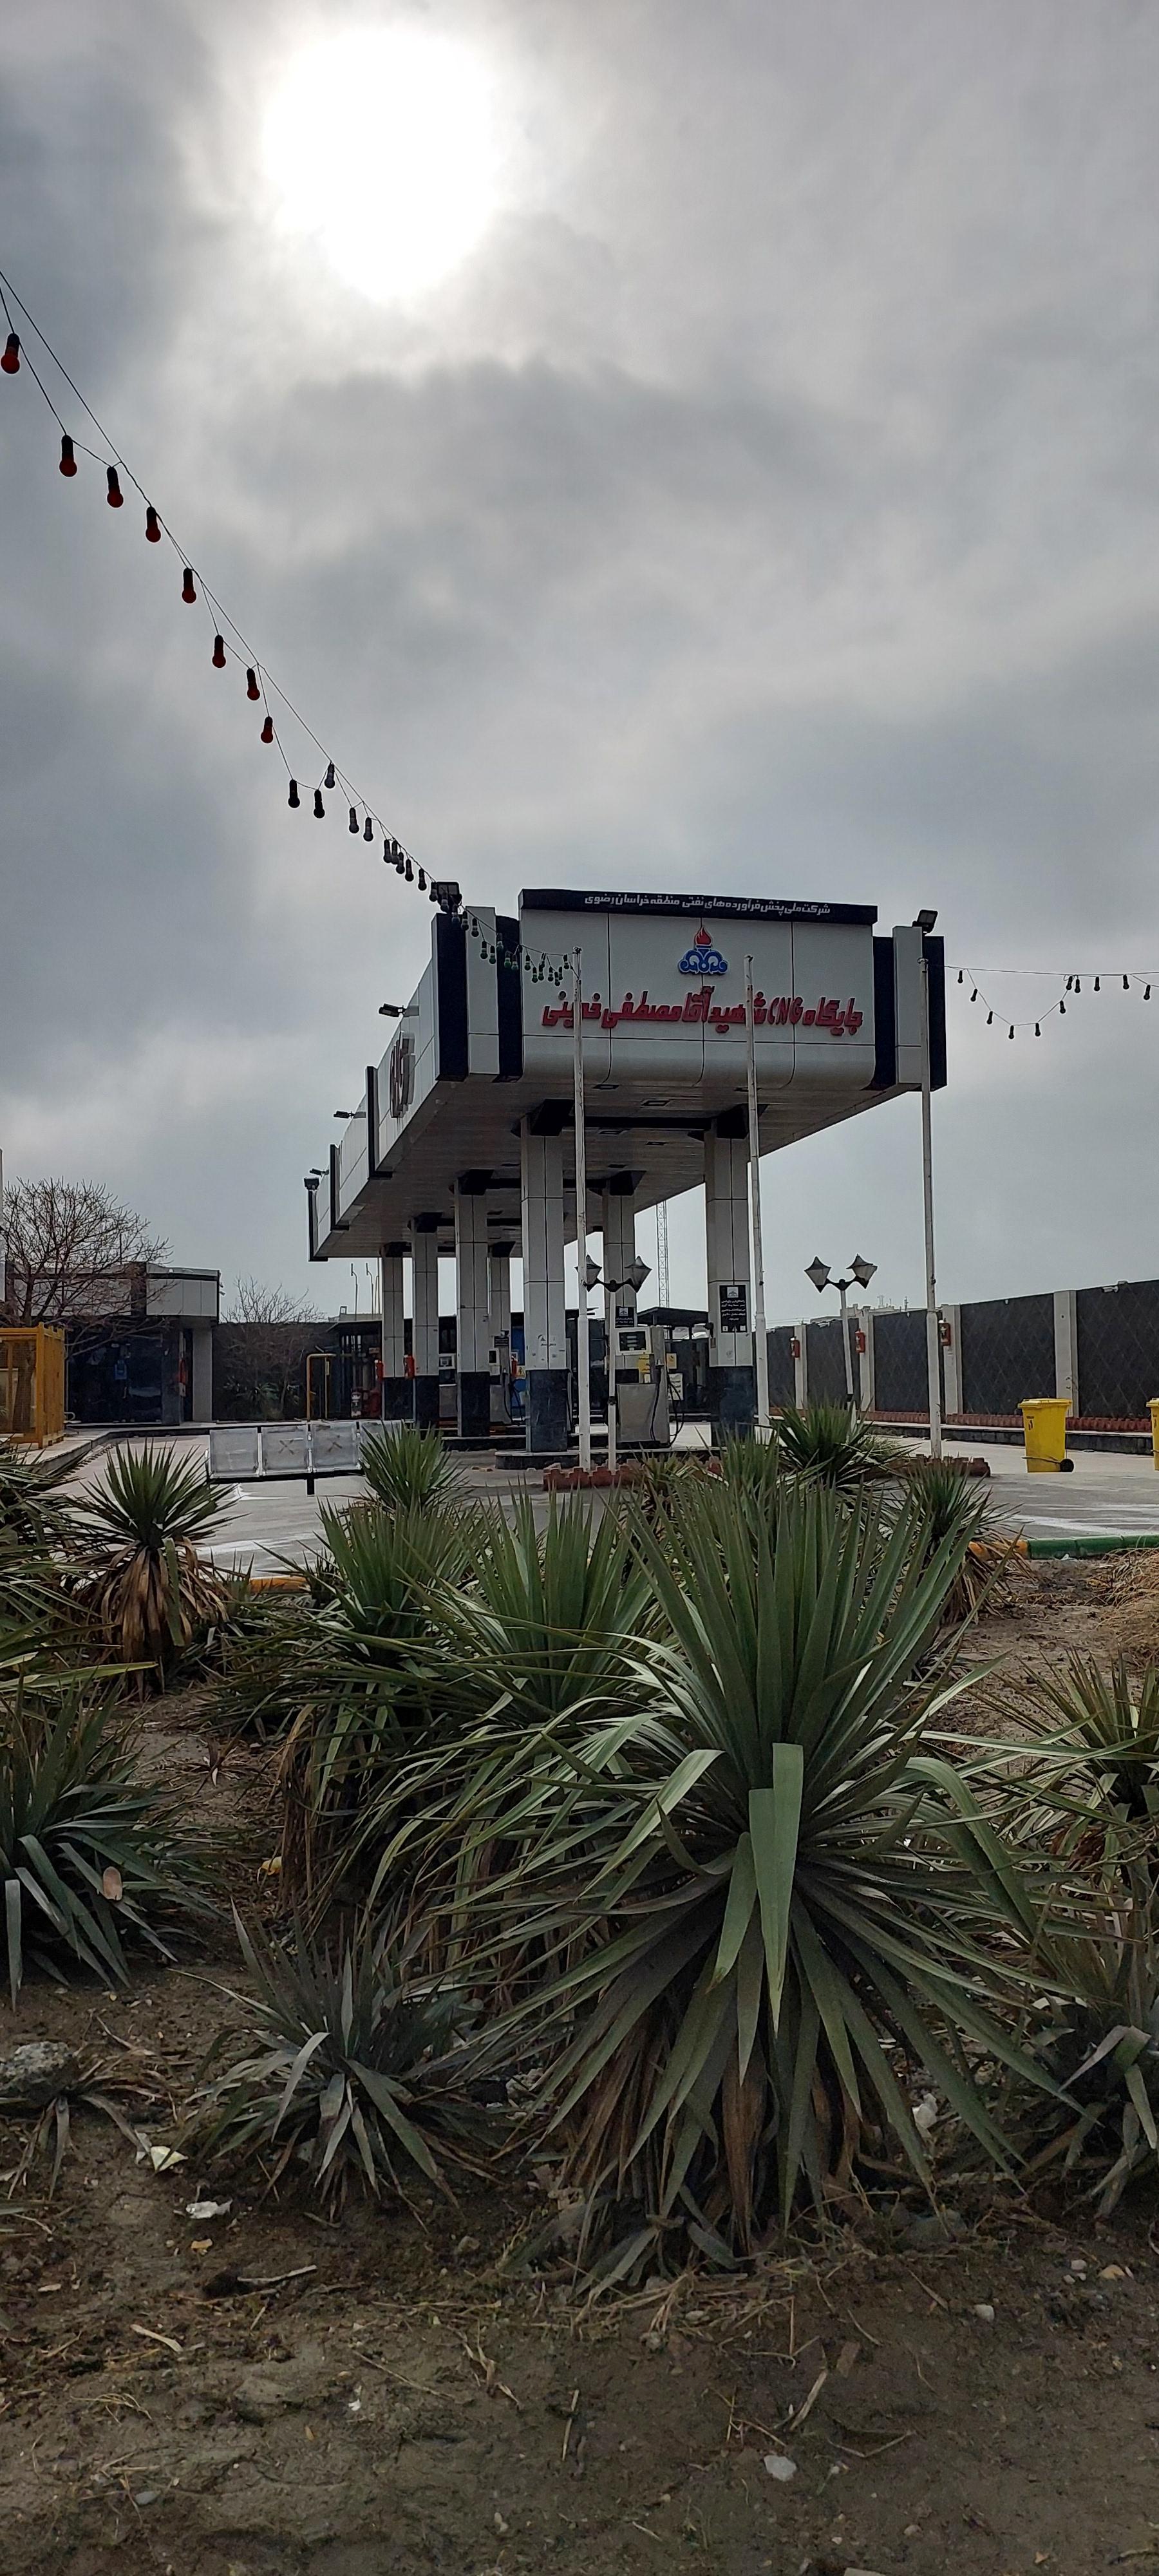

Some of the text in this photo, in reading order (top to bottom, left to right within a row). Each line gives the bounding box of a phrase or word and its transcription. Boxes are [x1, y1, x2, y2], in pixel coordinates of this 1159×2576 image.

[585, 893, 614, 905] رضوی
[615, 894, 650, 906] خراسان
[650, 895, 680, 905] منطقه
[682, 896, 704, 908] نفتی
[760, 900, 785, 916] پخش
[784, 902, 802, 914] ملی
[802, 904, 831, 916] شرکت
[601, 990, 683, 1028] مصطفی
[682, 985, 715, 1023] آقا
[768, 996, 804, 1025] CNG
[708, 991, 768, 1034] شهید
[802, 997, 863, 1036] جایگاه
